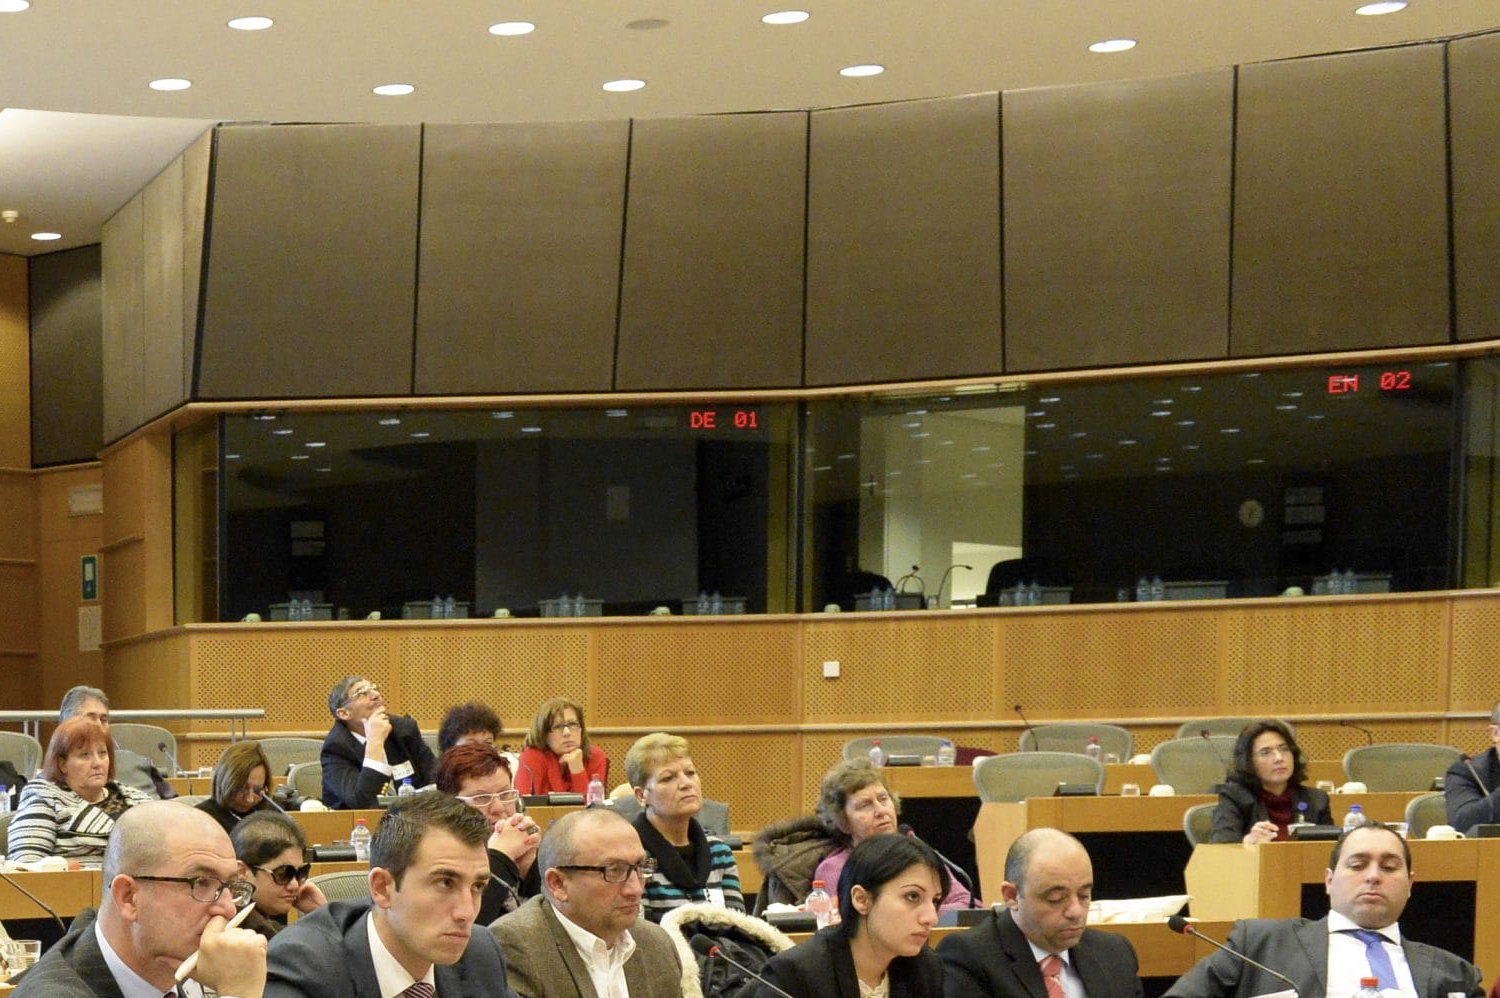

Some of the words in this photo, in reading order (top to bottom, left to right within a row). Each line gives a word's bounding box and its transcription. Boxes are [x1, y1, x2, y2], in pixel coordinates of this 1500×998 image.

[1380, 371, 1411, 390] 02
[690, 411, 717, 429] DE
[734, 411, 757, 429] 01
